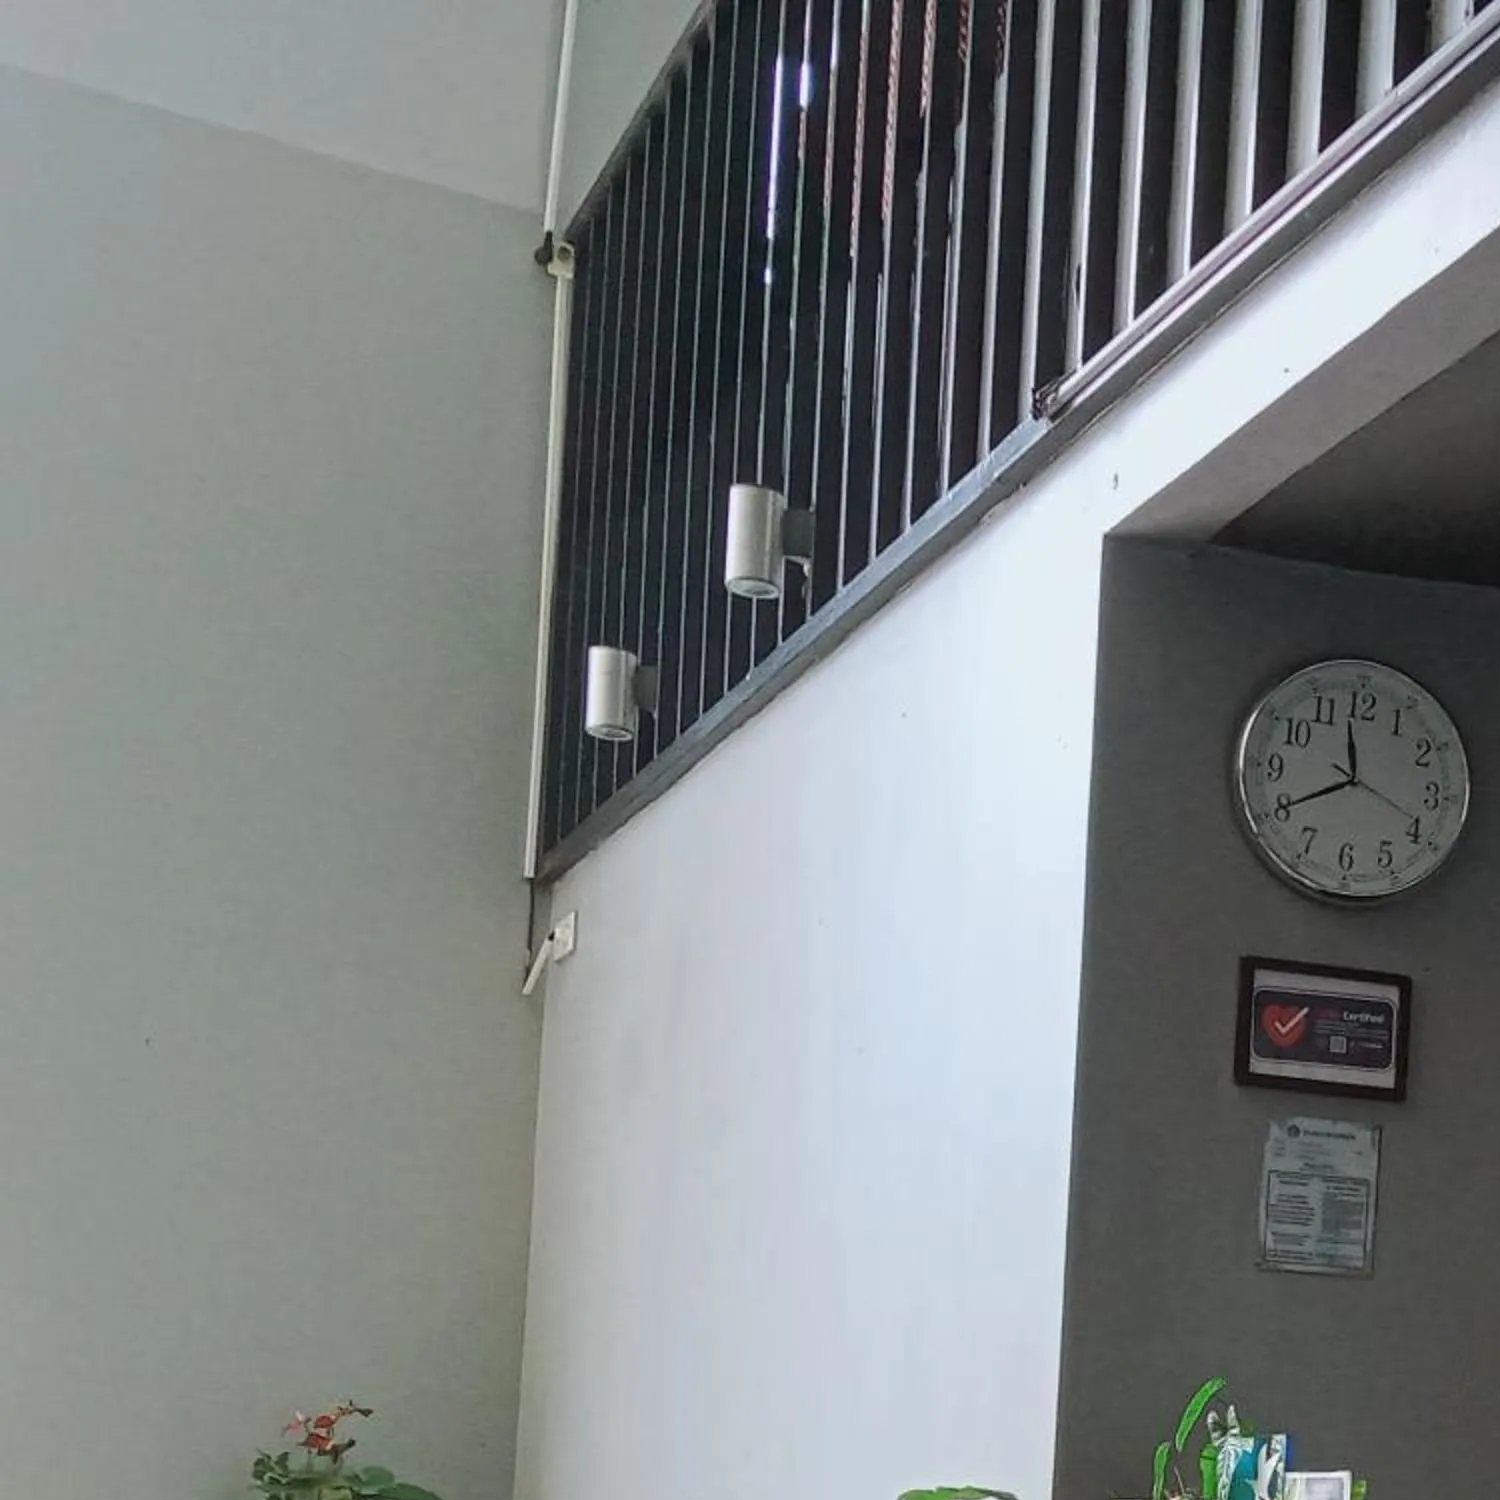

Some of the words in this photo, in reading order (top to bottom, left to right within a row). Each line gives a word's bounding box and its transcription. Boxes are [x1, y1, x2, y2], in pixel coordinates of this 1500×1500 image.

[1312, 696, 1335, 726] 11
[1349, 691, 1377, 722] 12
[1283, 717, 1311, 748] 10
[1392, 709, 1402, 737] 1
[1267, 753, 1284, 782] 9
[1415, 738, 1432, 768] 2
[1274, 793, 1291, 822] 8
[1424, 781, 1440, 811] 3
[1301, 827, 1318, 855] 7
[1406, 817, 1421, 844] 4
[1338, 843, 1354, 872] 6
[1377, 840, 1393, 868] 5
